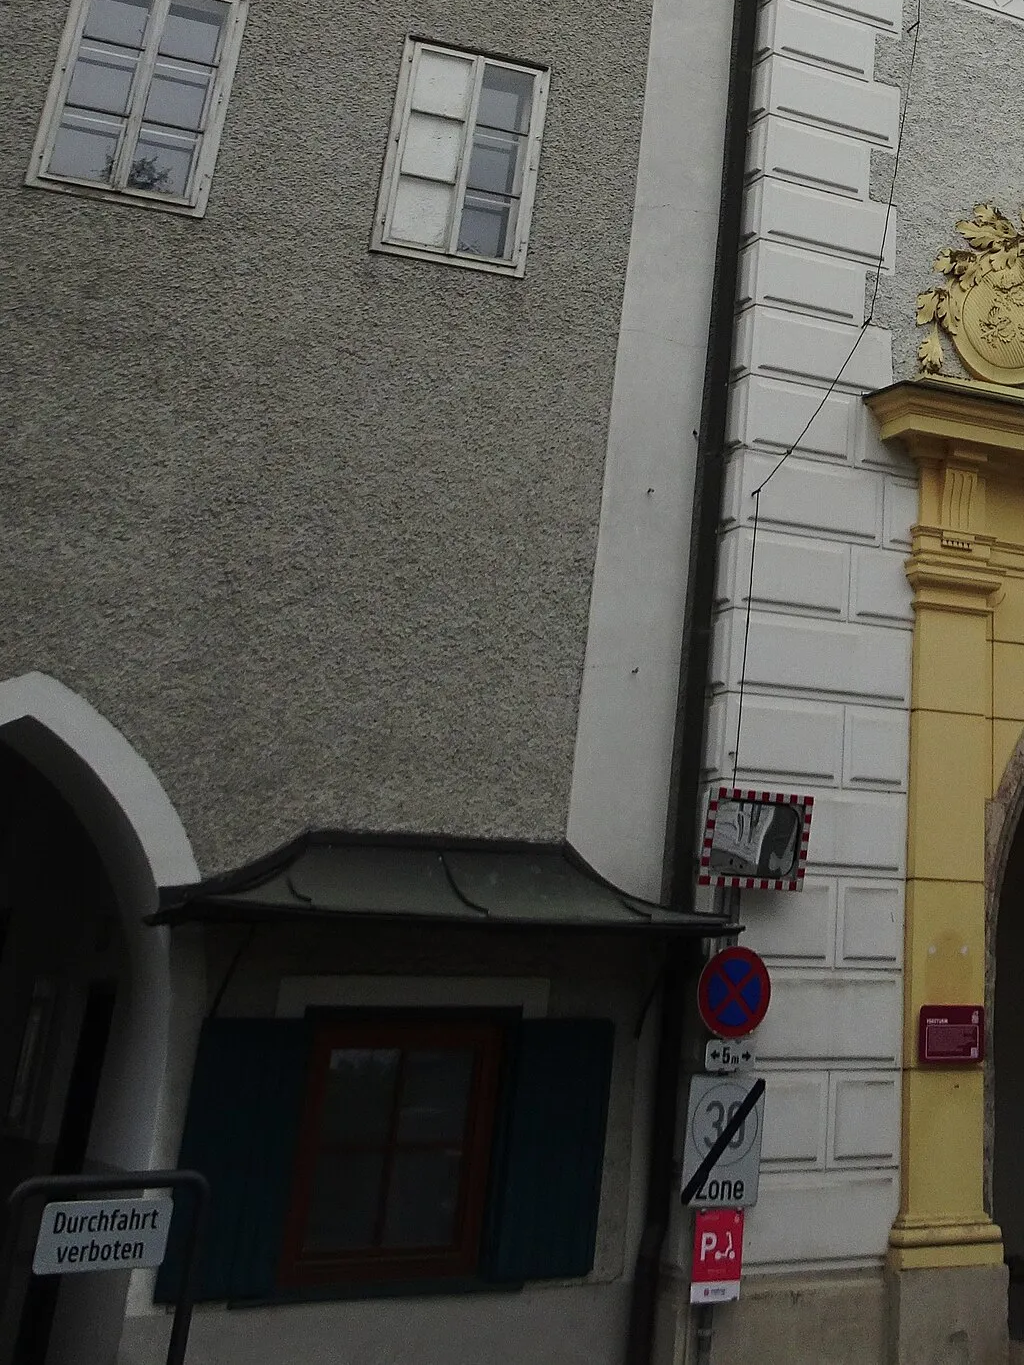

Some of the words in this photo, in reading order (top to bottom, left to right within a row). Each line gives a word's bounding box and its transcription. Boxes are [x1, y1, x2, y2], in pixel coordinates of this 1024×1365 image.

[703, 1100, 745, 1150] 30
[53, 1208, 159, 1235] Durchfahrt
[56, 1239, 144, 1264] verboten
[700, 1231, 717, 1262] P
